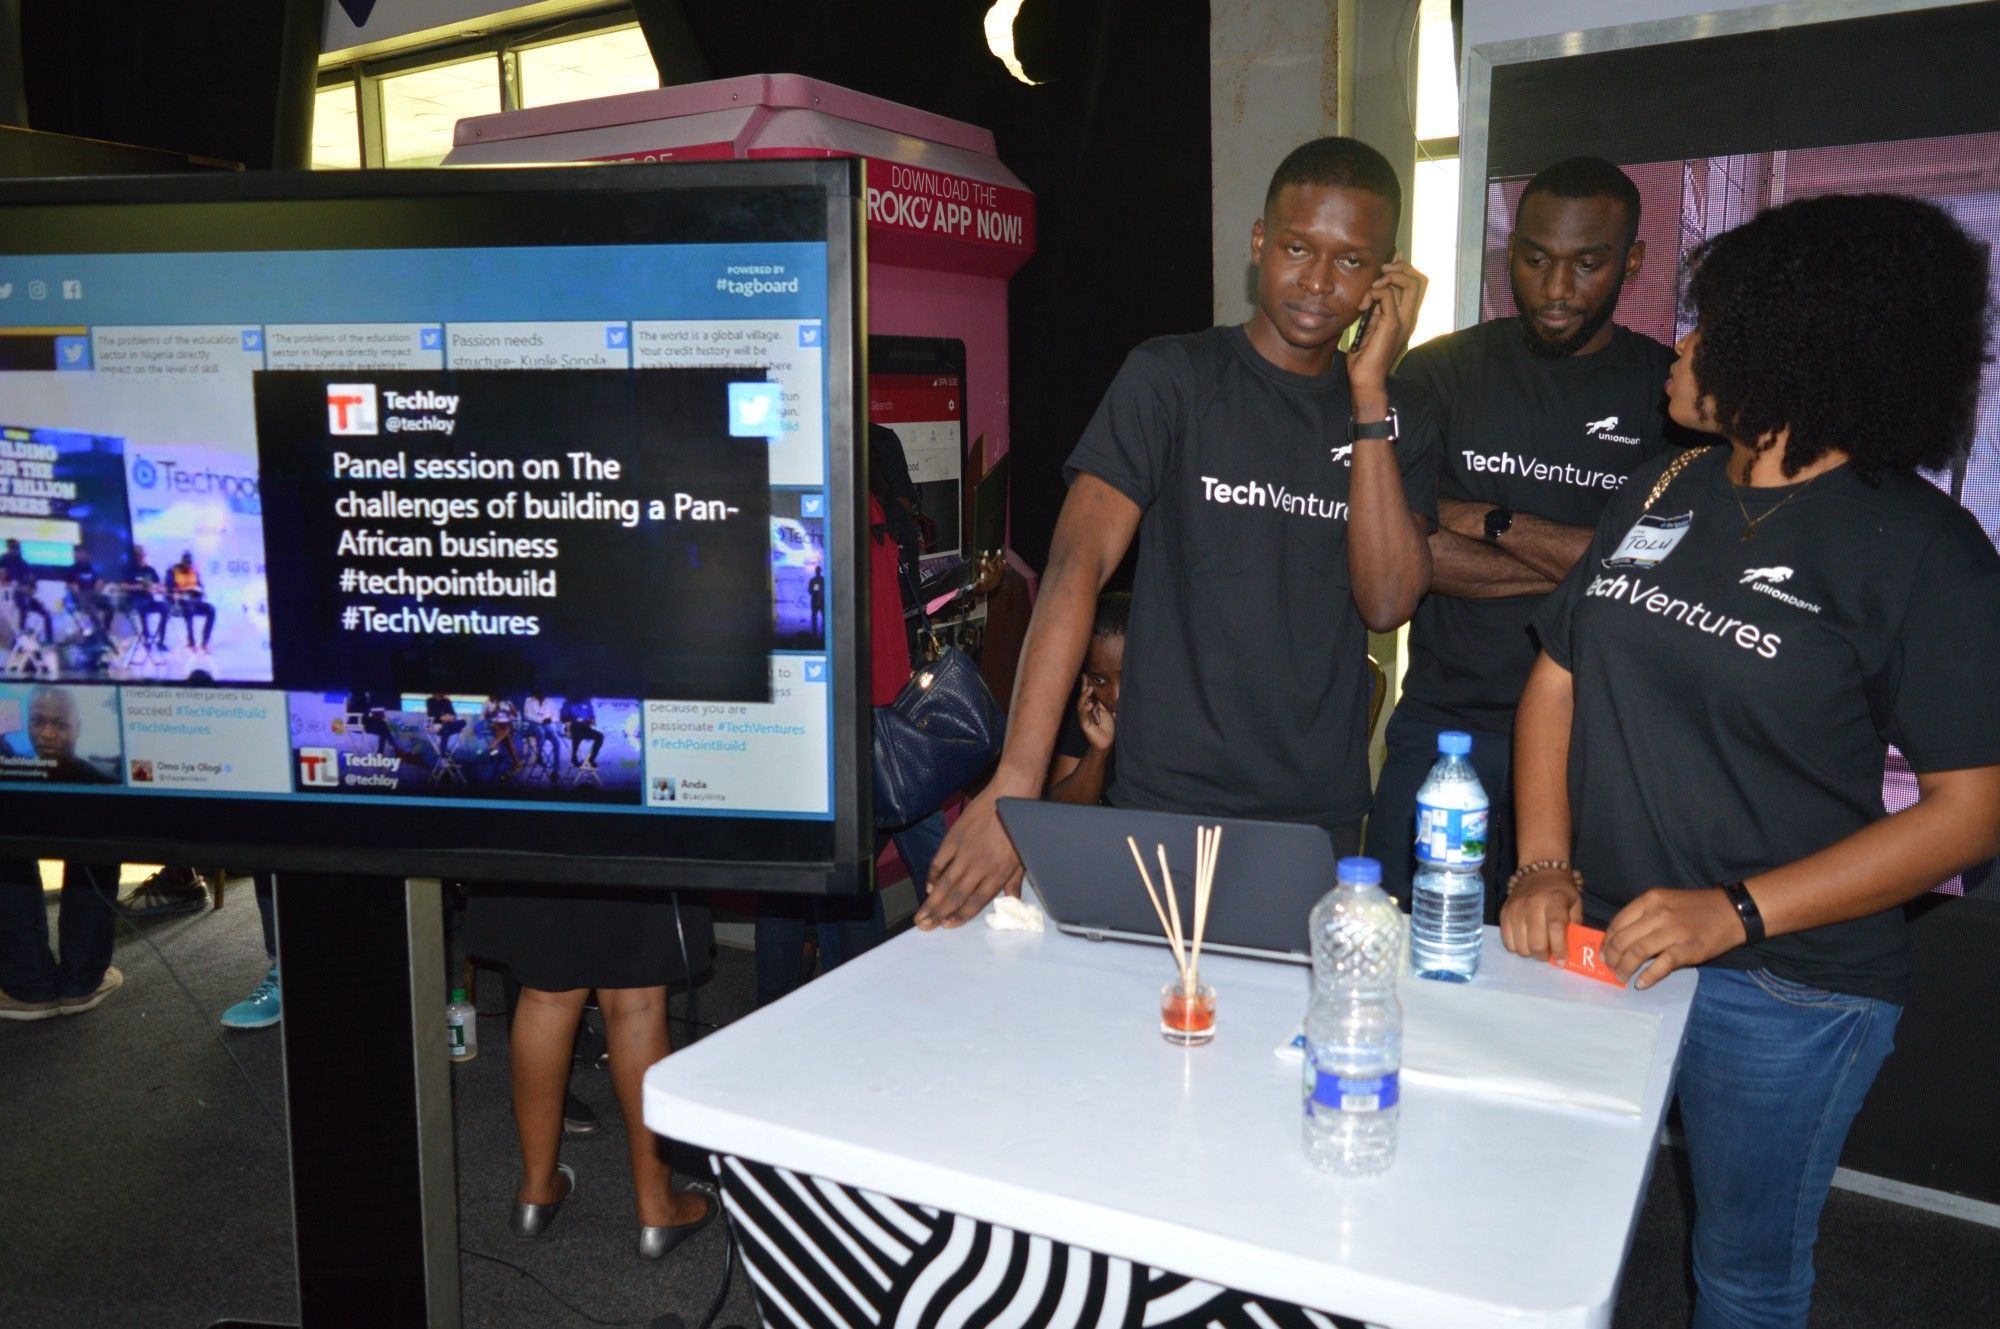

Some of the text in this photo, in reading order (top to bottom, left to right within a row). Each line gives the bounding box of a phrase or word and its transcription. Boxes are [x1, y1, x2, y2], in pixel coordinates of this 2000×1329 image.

[891, 165, 997, 208] DOWNLOAD THE
[933, 201, 972, 236] APP
[977, 208, 1023, 245] NOW!
[727, 265, 785, 275] POWERED BY
[716, 277, 799, 298] #tagboard
[117, 335, 161, 347] problems
[174, 335, 191, 345] the
[192, 334, 239, 345] education
[294, 333, 335, 345] problems
[349, 333, 363, 343] the
[366, 333, 411, 343] education
[452, 333, 544, 347] Passion needs
[639, 331, 657, 342] The
[660, 330, 689, 341] world
[691, 331, 700, 341] is
[702, 333, 709, 341] a
[711, 330, 744, 343] global
[176, 349, 211, 362] directly
[346, 347, 378, 359] directly
[380, 347, 412, 359] impact
[639, 345, 767, 359] Your credit history will be
[165, 363, 187, 374] level
[201, 363, 219, 374] skill
[382, 390, 459, 415] Techloy
[385, 415, 456, 436] @techloy
[1598, 432, 1641, 445] unionban
[333, 451, 621, 480] Panel session on The
[335, 491, 740, 527] challenges of building a Pan-
[336, 529, 559, 559] African business
[339, 567, 558, 602] #techpointbuild
[1751, 579, 1822, 615] unionbank
[341, 606, 540, 637] #TechVentures
[1585, 573, 1782, 659] echVentures
[778, 668, 791, 678] to
[127, 705, 172, 716] succeed
[650, 703, 747, 717] because you are
[129, 721, 211, 735] #TechVentures
[650, 721, 806, 736] passionate #TechVentures
[651, 737, 747, 752] #TechPointBuild
[343, 752, 401, 772] Techloy
[345, 774, 399, 790] @techloy
[681, 779, 708, 789] Anda
[1582, 946, 1595, 969] R
